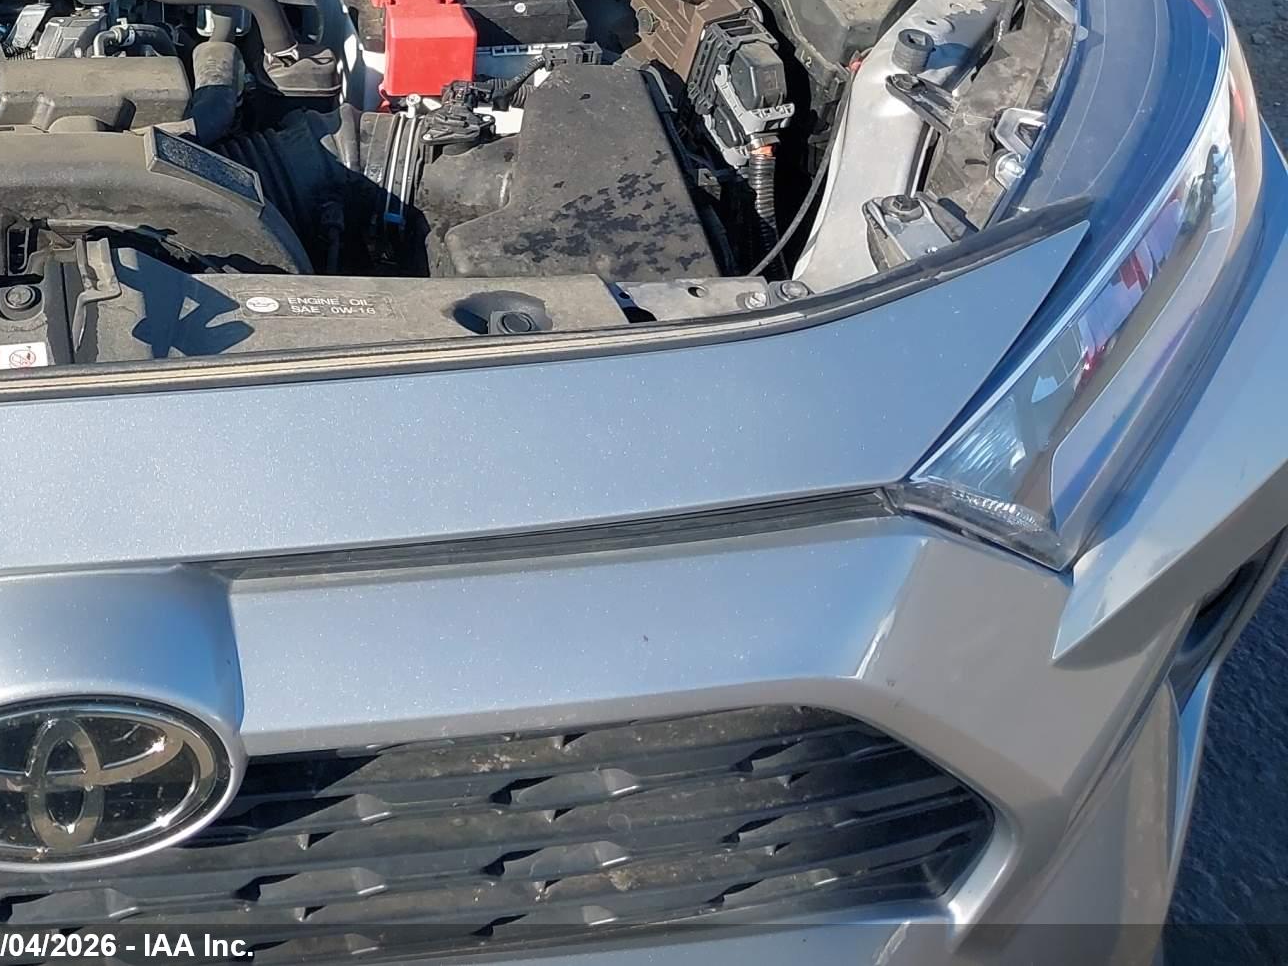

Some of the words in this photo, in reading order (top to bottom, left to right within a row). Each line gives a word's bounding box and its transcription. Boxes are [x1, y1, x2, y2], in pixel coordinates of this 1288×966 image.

[287, 297, 340, 306] ENGINE
[349, 298, 373, 306] OIL
[291, 305, 321, 314] SAE
